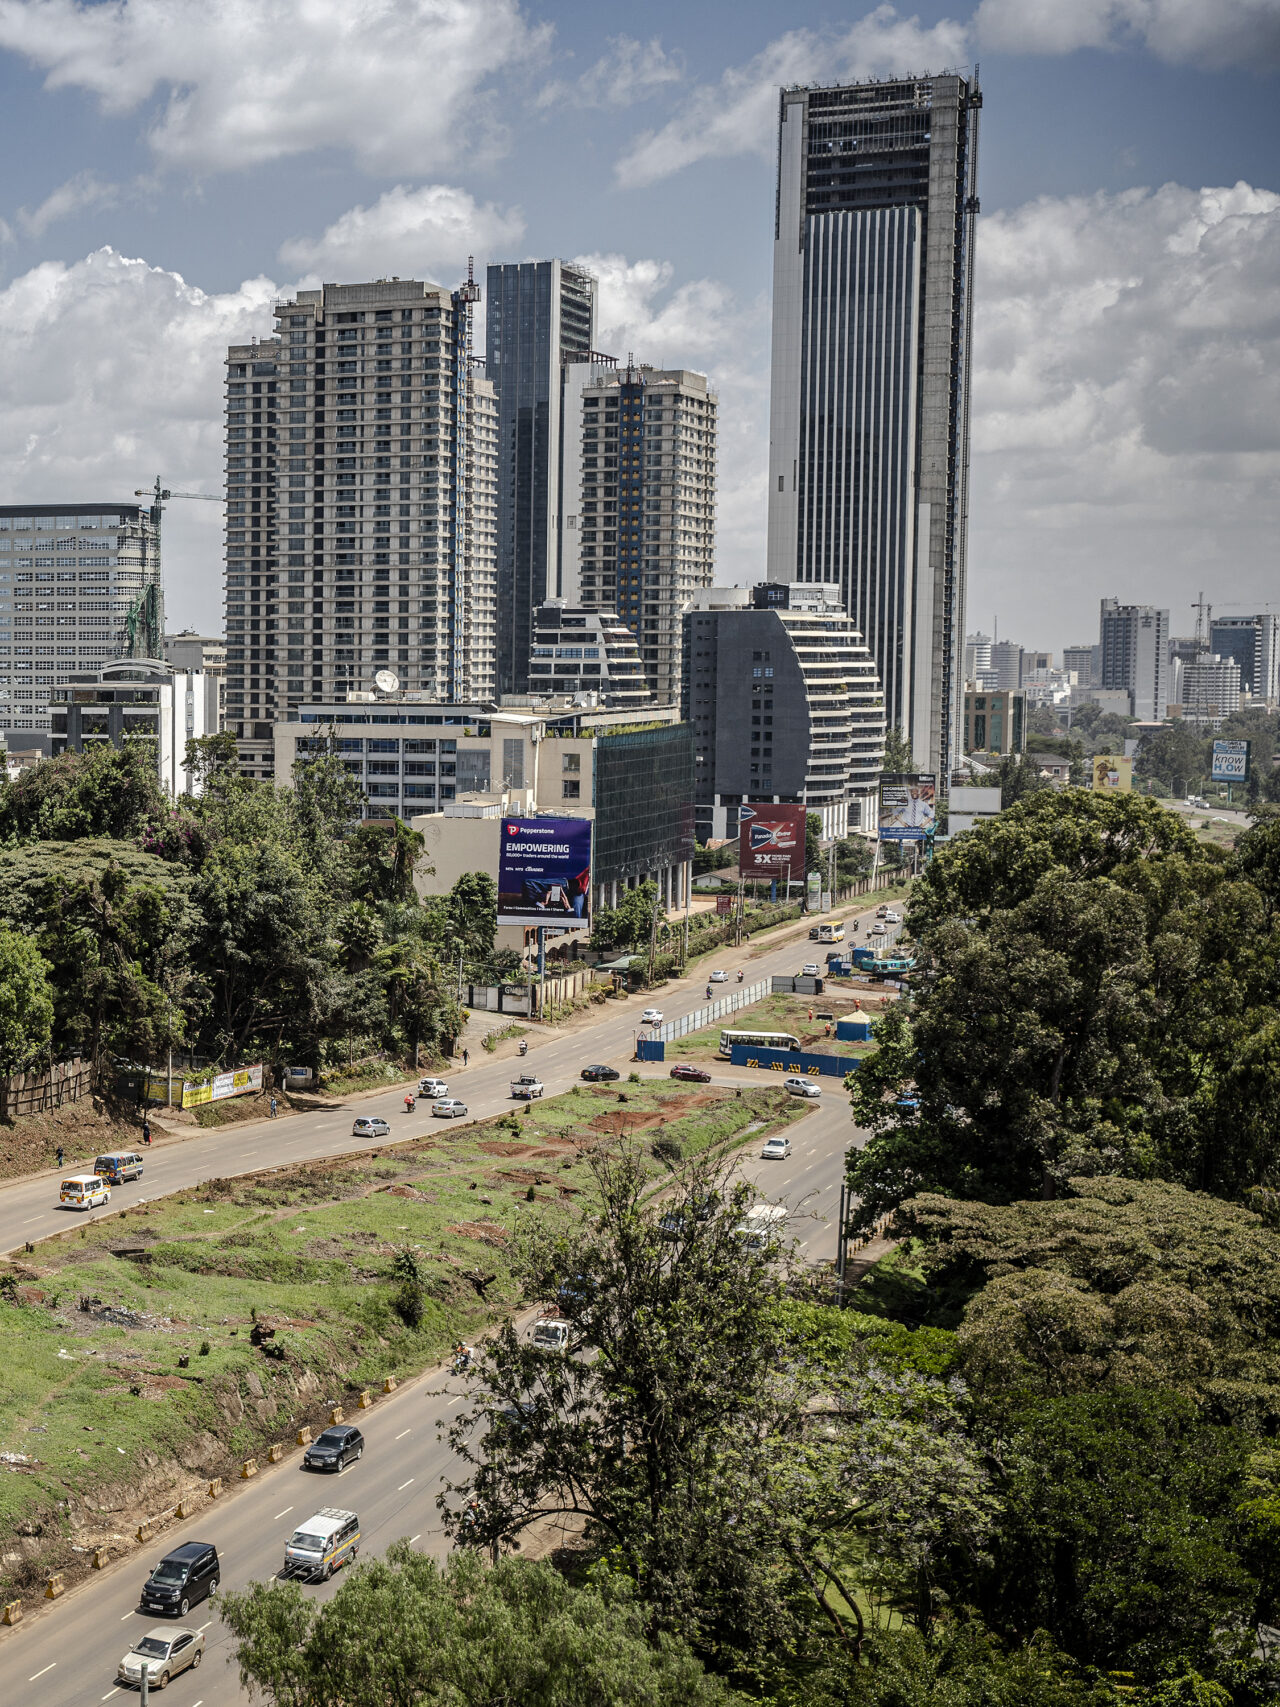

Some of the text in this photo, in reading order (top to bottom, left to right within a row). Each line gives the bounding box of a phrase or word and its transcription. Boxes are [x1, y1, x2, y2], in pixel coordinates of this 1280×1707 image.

[1214, 754, 1243, 764] know
[520, 827, 554, 835] Pepperstone
[506, 843, 570, 853] EMPOWERING
[754, 854, 772, 864] 3X
